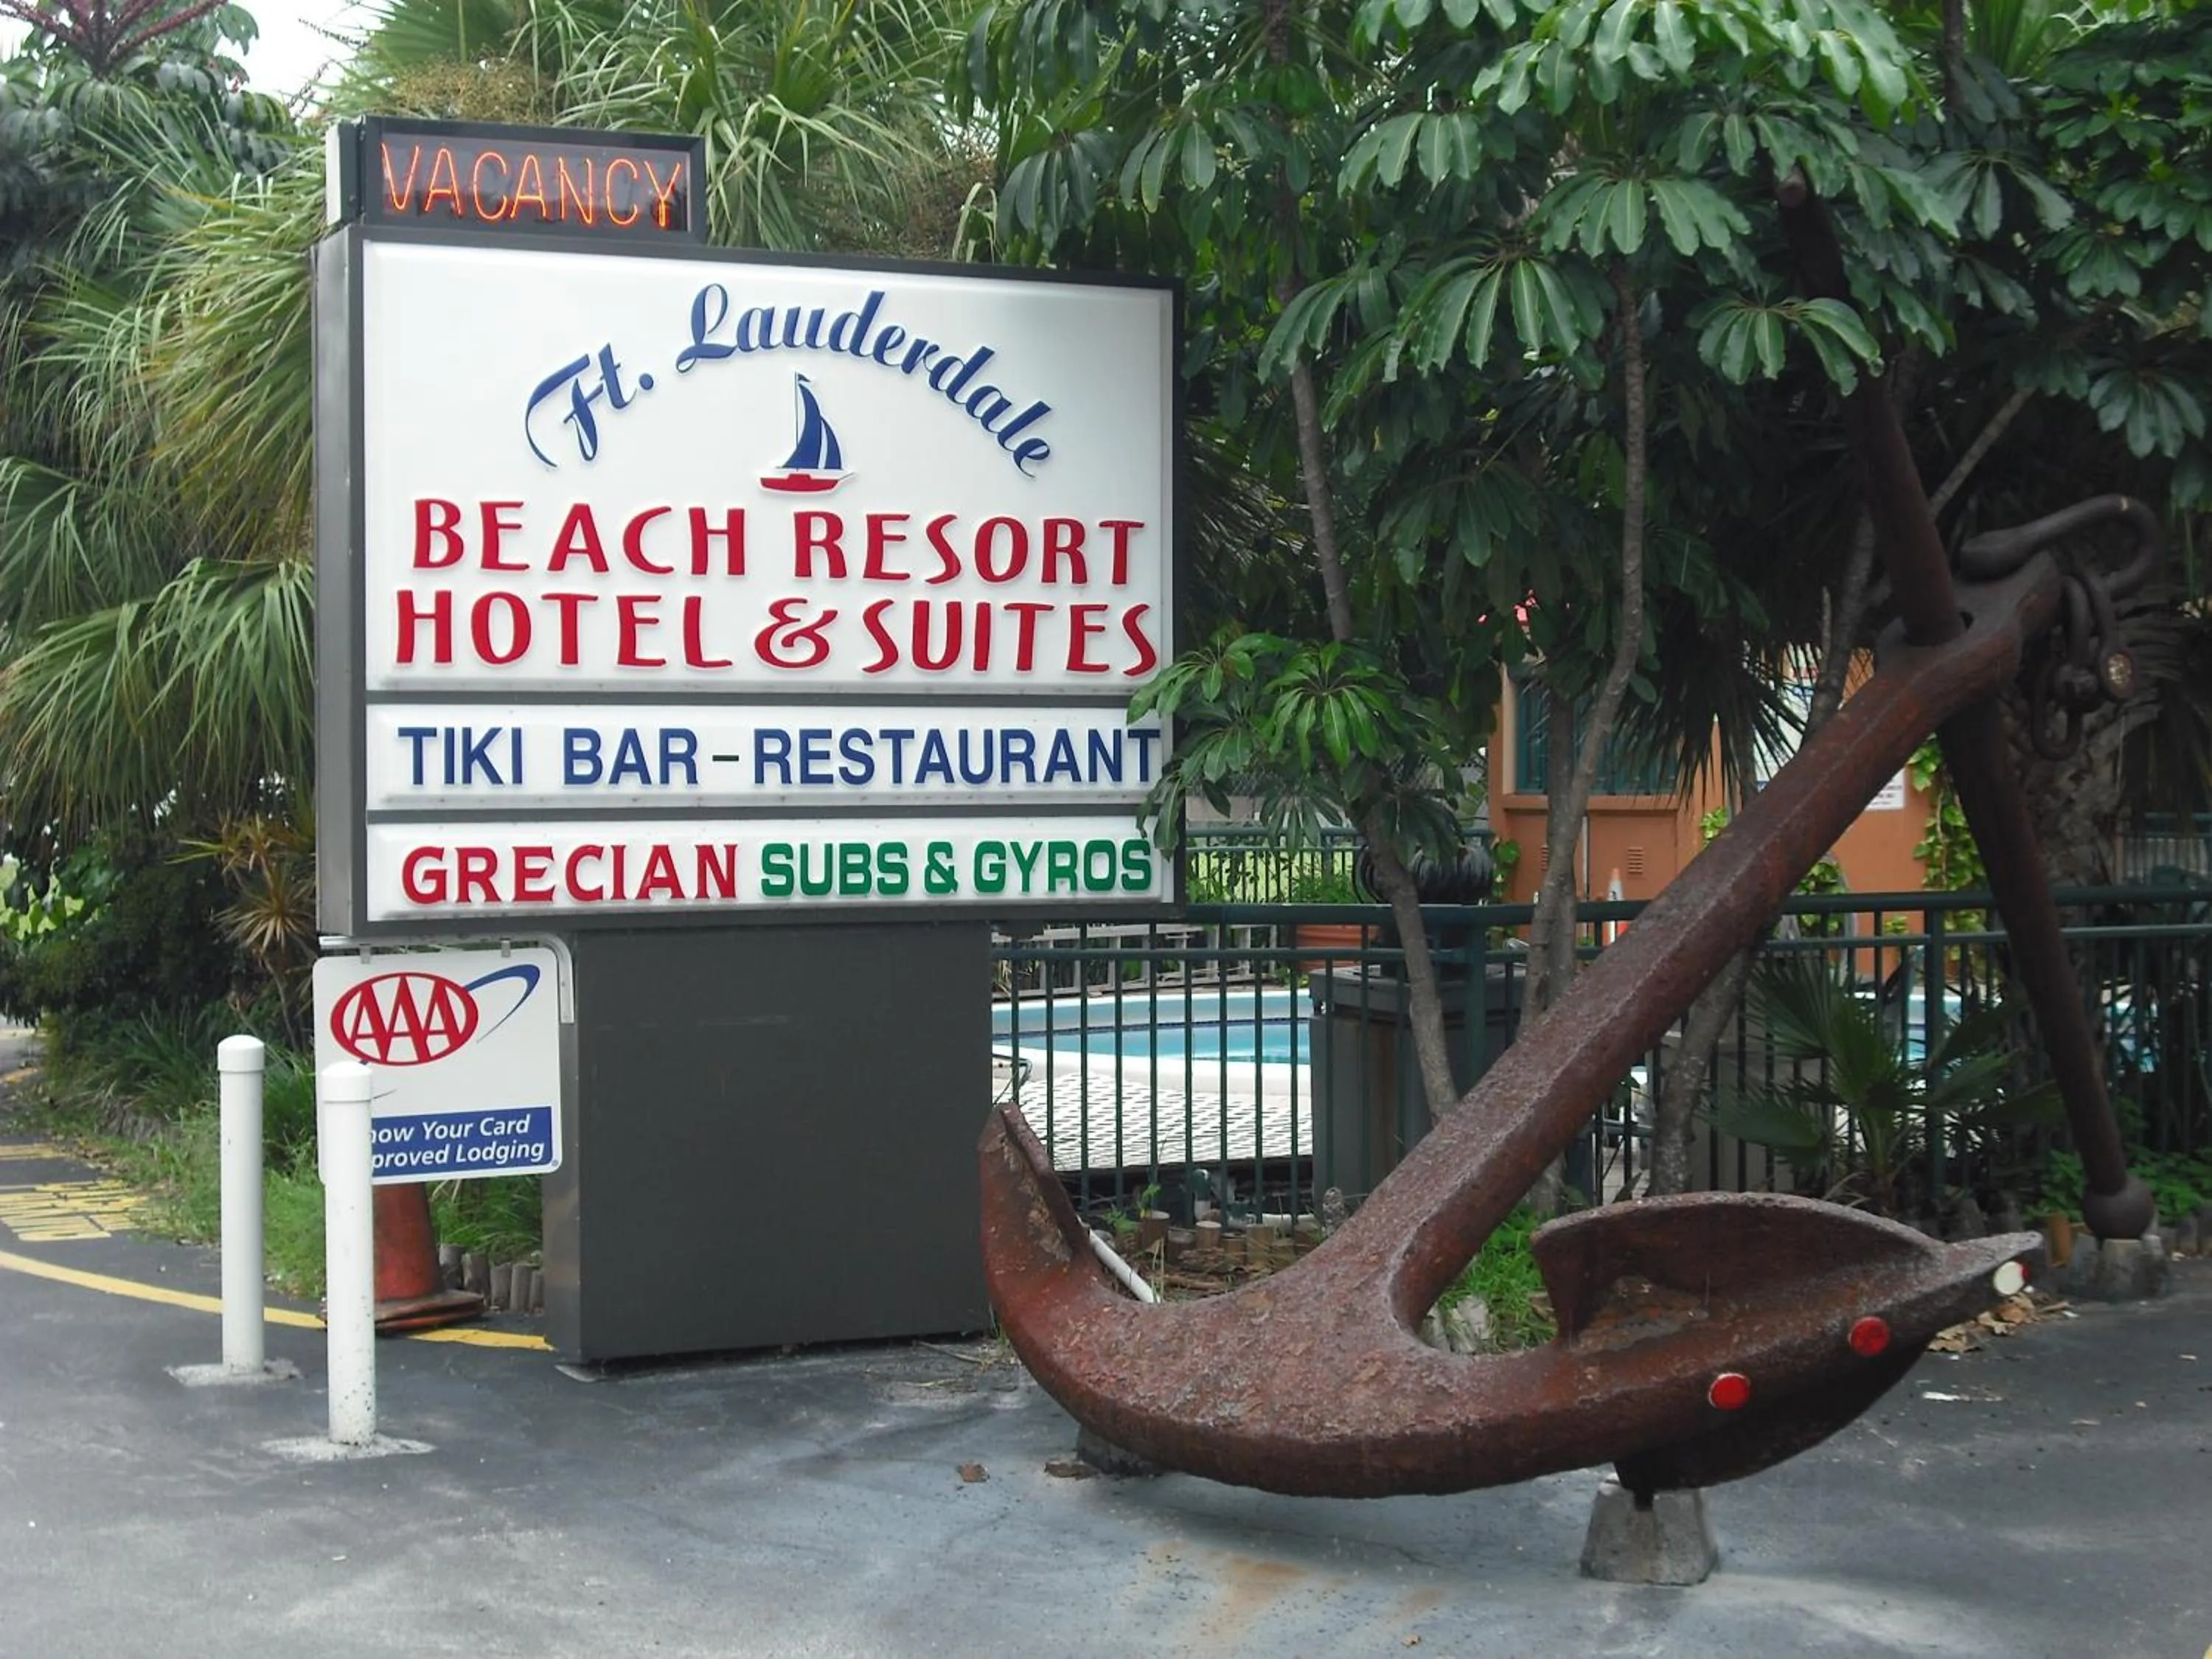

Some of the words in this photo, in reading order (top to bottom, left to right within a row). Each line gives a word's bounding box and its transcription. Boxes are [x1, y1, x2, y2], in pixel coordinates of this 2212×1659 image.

[380, 143, 683, 227] VACANCY
[524, 342, 654, 467] Ft.
[675, 282, 1051, 480] Lauderdale
[412, 498, 745, 575] BEACH
[793, 510, 1146, 585] RESORT
[396, 589, 732, 667] HOTEL
[754, 597, 838, 669] &
[861, 598, 1157, 676] SUITES
[397, 726, 523, 785] TIKI
[401, 843, 739, 904] GRECIAN
[760, 841, 909, 897] SUBS
[924, 842, 959, 894] &
[973, 838, 1152, 894] GYROS
[349, 975, 463, 1062] AAA
[422, 1121, 474, 1141] Your
[479, 1113, 531, 1137] Card
[455, 1139, 545, 1165] Lodging
